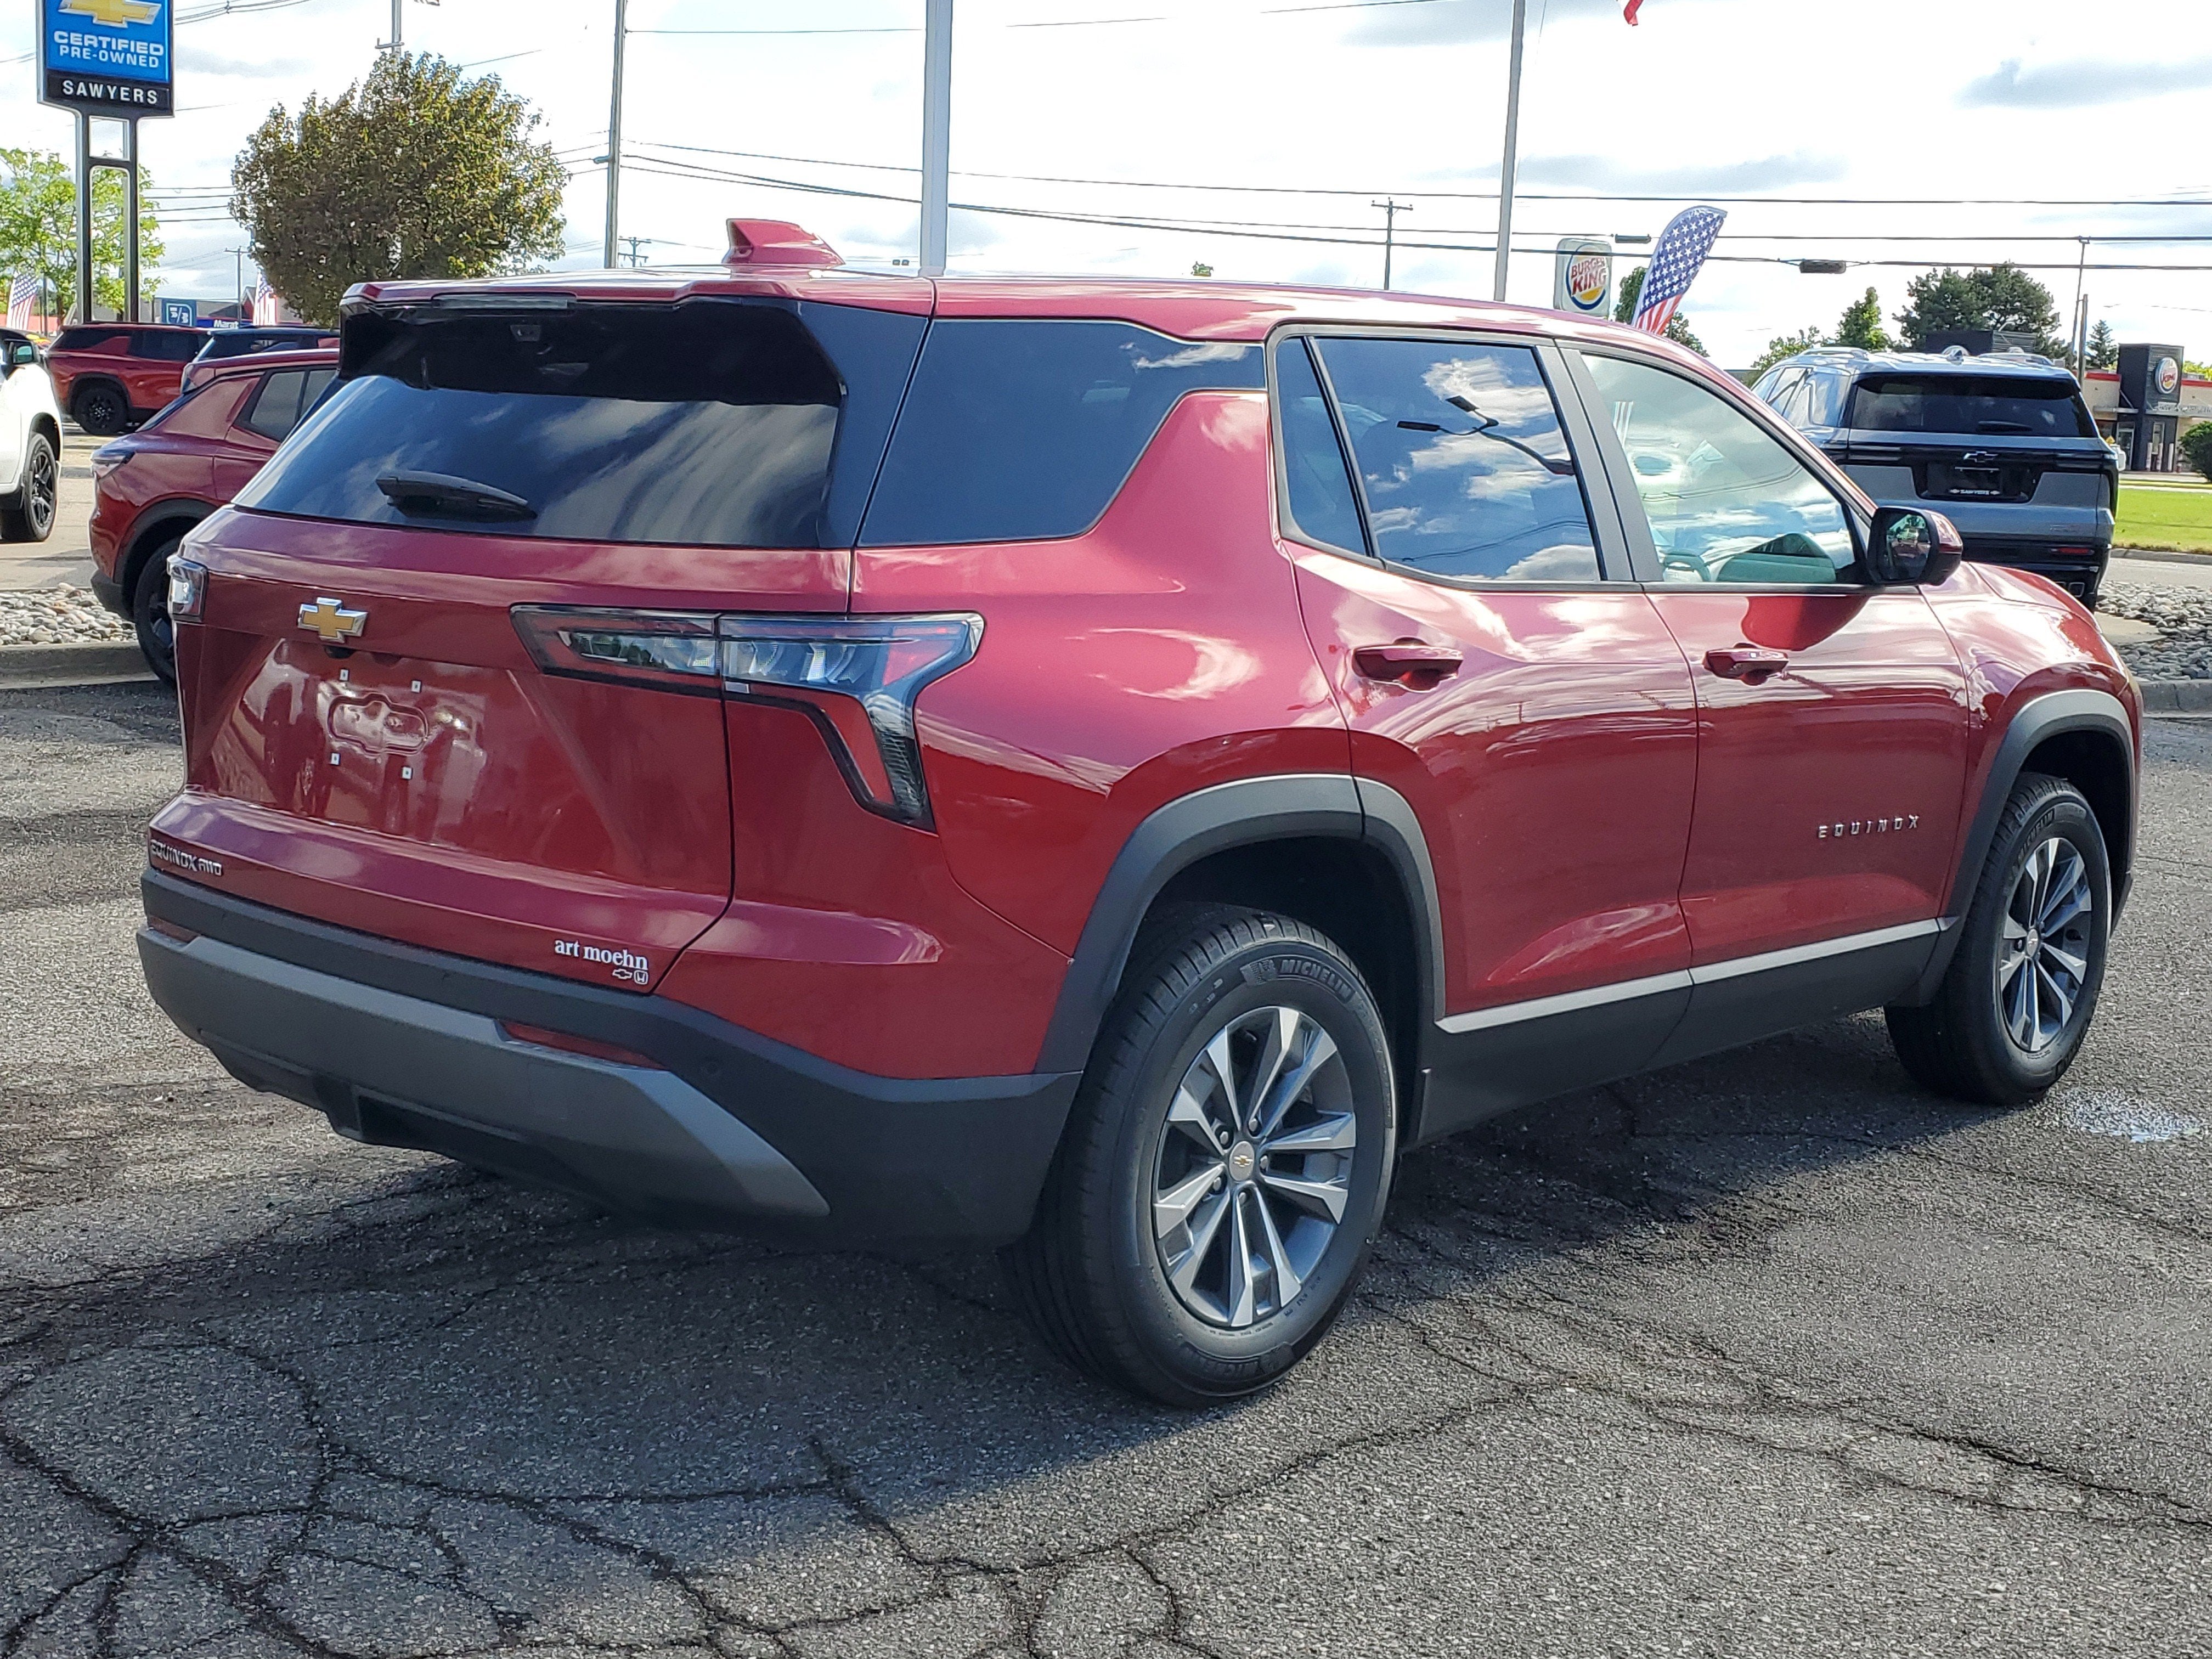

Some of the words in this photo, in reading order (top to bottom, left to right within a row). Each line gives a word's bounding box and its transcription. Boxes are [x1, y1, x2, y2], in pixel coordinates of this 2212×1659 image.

[54, 31, 164, 56] CERTIFIED
[59, 45, 159, 68] PRE-OWNED
[62, 80, 158, 104] SAWYERS
[1571, 256, 1605, 279] BURGER
[1571, 267, 1607, 296] KING
[1818, 814, 1920, 838] EQUINOX
[150, 839, 198, 872] EQUINOX
[554, 939, 580, 957] art
[583, 946, 648, 970] moehn
[1280, 959, 1352, 998] MICHELIN
